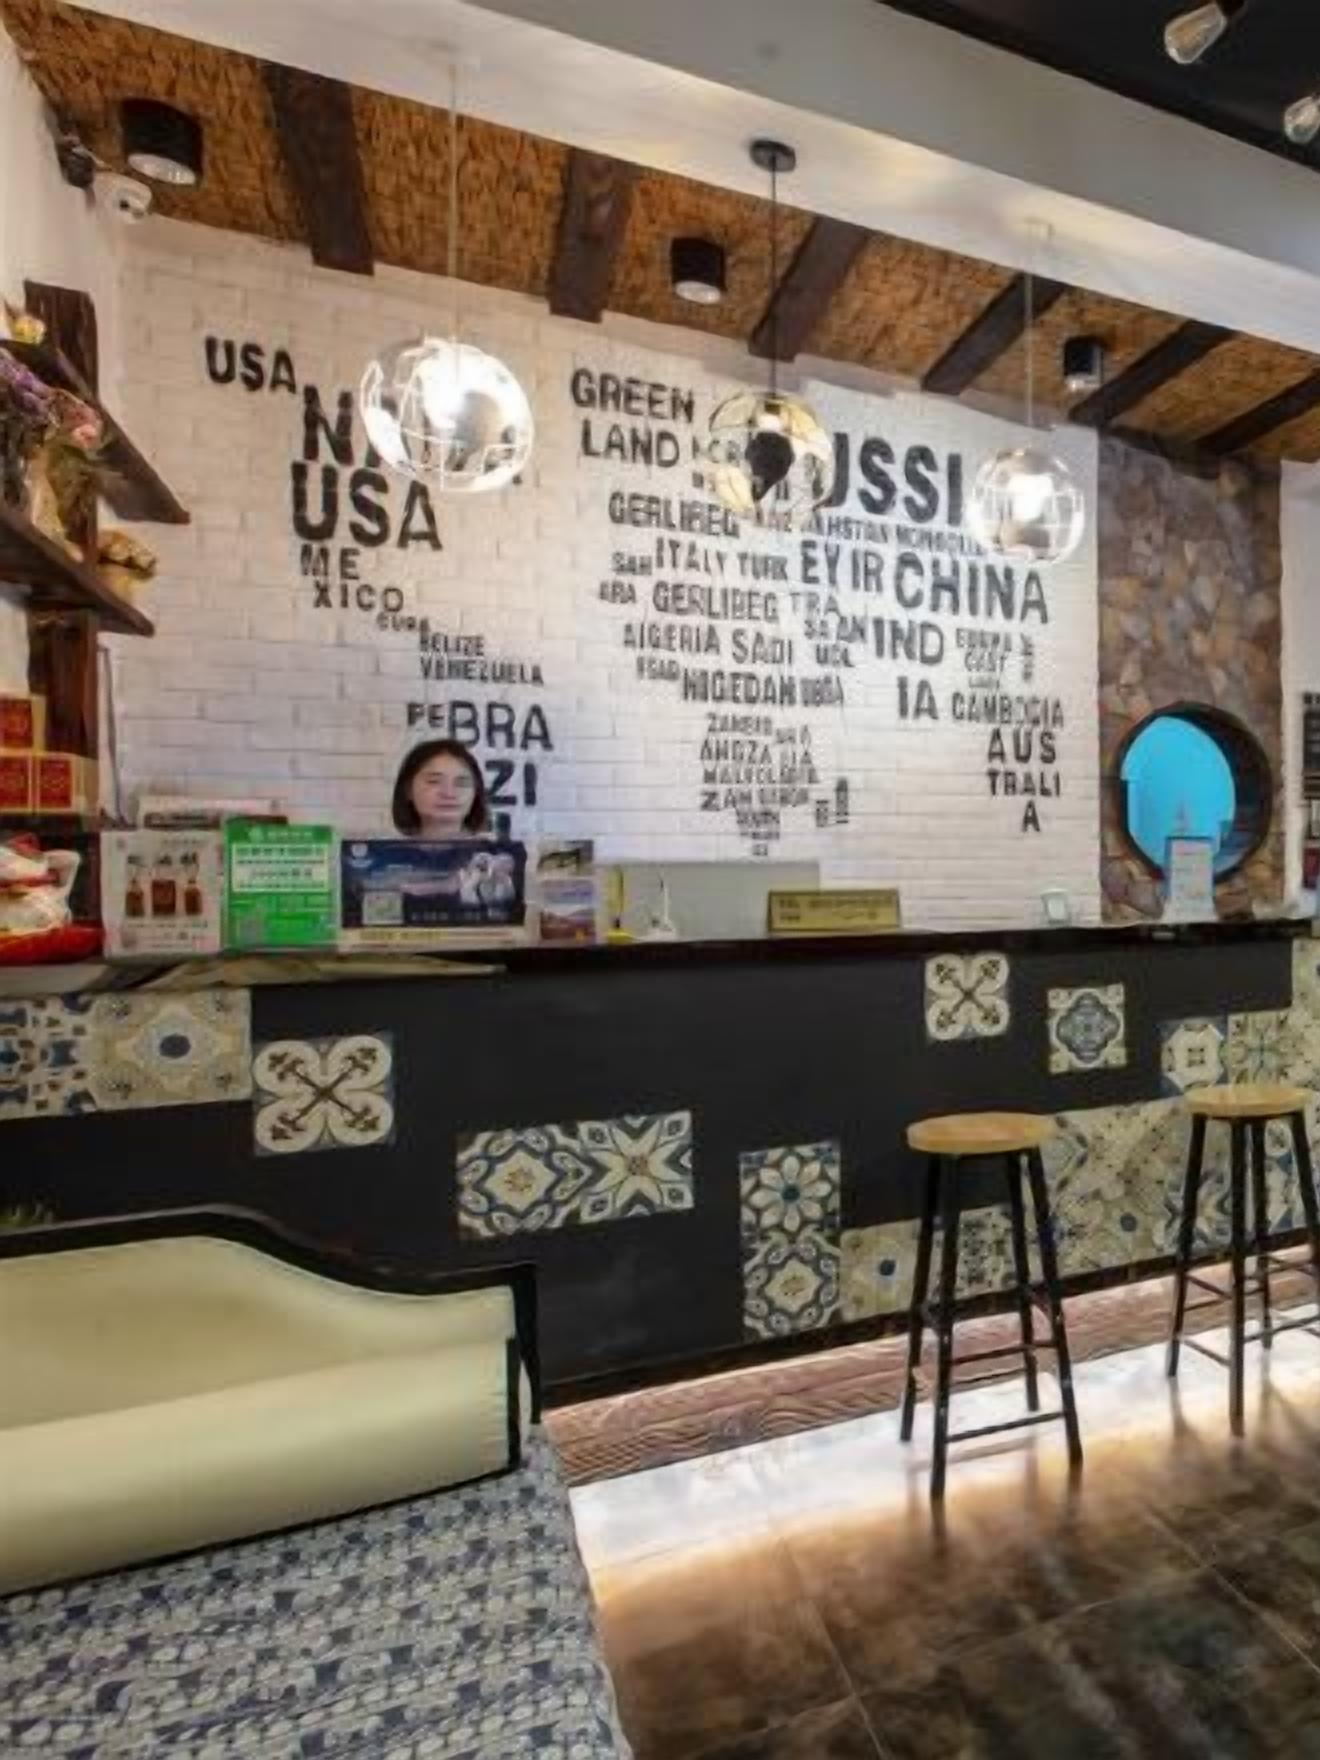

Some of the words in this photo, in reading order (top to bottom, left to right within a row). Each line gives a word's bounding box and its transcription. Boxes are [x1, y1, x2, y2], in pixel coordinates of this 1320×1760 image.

[205, 336, 296, 394] USA
[570, 367, 694, 424] GREEN
[581, 418, 680, 468] LAND
[292, 461, 442, 550] USA
[301, 544, 360, 581] ME
[312, 581, 405, 614] XICO
[895, 551, 1049, 624] CHINA
[872, 617, 945, 666] IND
[896, 675, 940, 720] IA
[449, 700, 554, 751] BRA
[987, 727, 1057, 764] AUS
[985, 768, 1061, 798] TRALI
[1021, 799, 1041, 833] A
